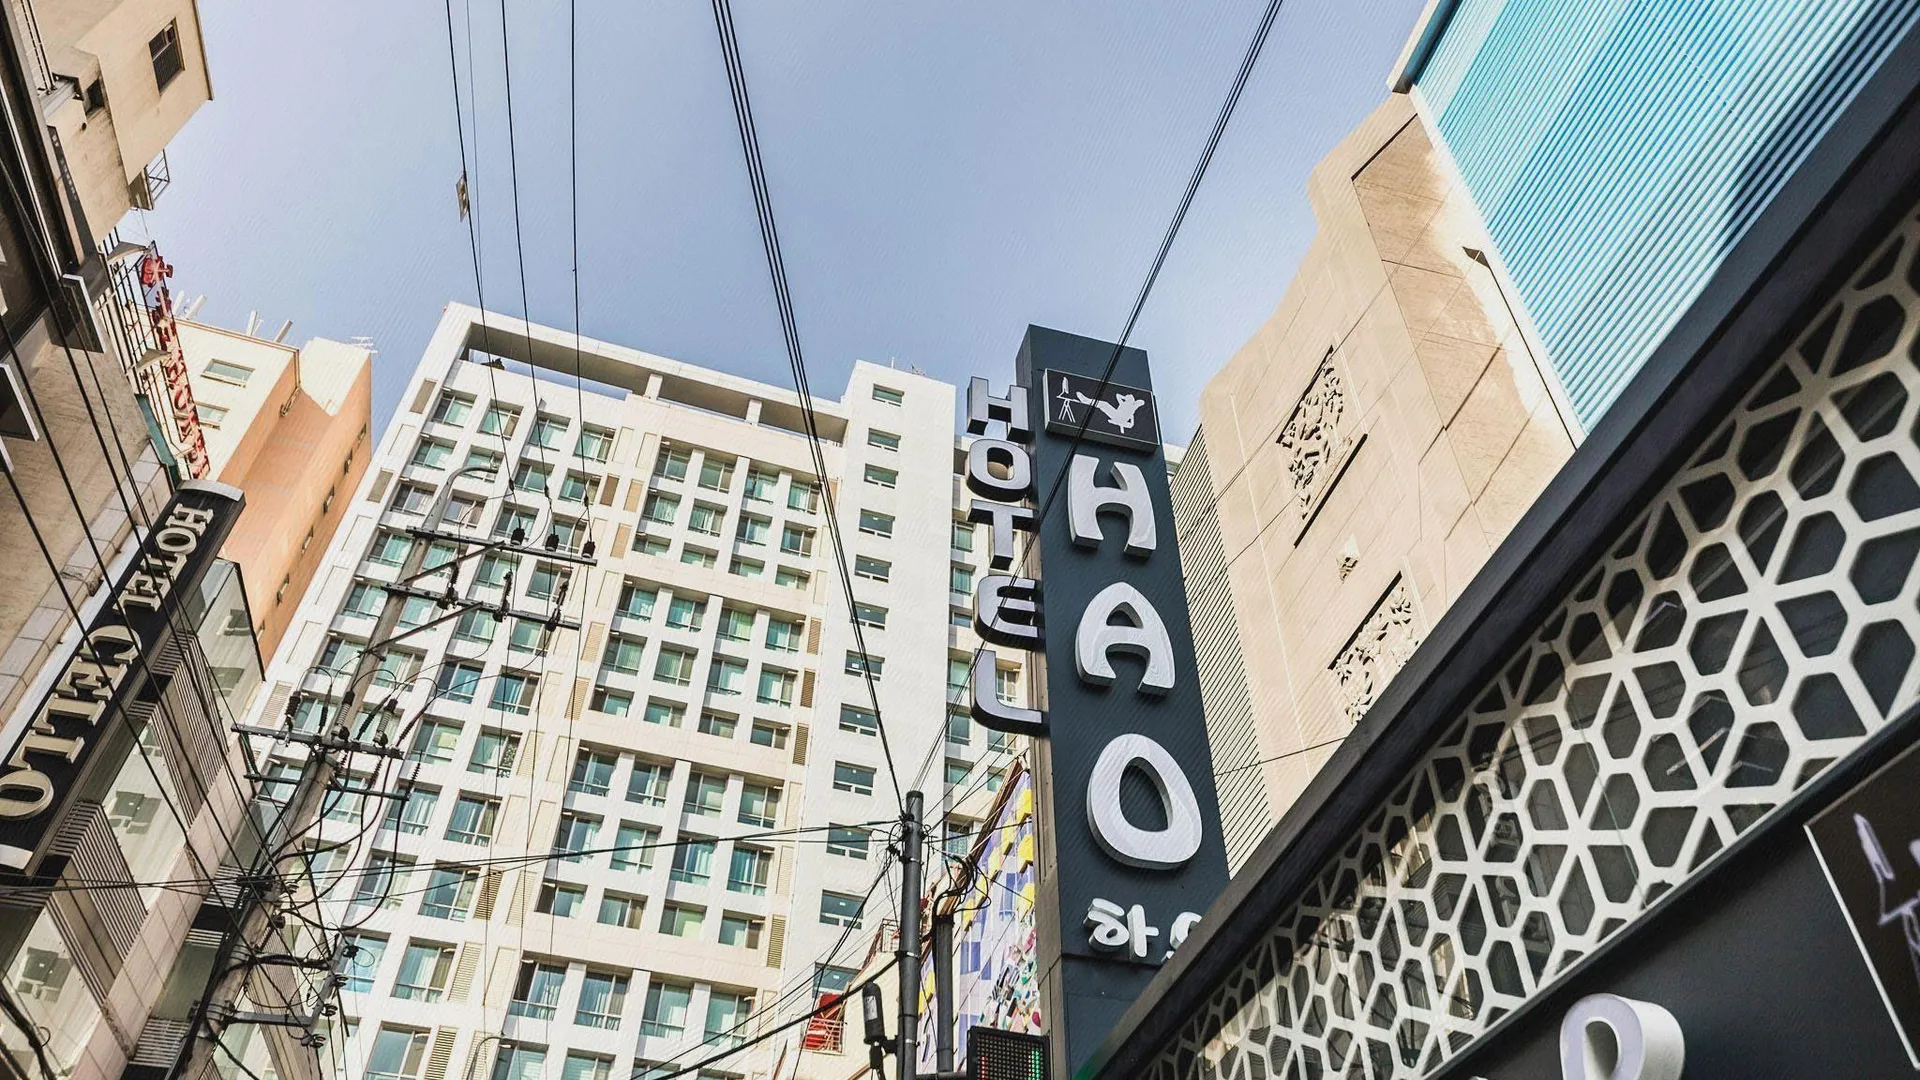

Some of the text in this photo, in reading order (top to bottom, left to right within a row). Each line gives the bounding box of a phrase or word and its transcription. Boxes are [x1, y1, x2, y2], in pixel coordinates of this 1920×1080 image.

[112, 502, 214, 613] HOTEL
[967, 376, 1045, 735] HOTEL
[1067, 453, 1203, 868] HAO
[0, 624, 143, 820] CELLO
